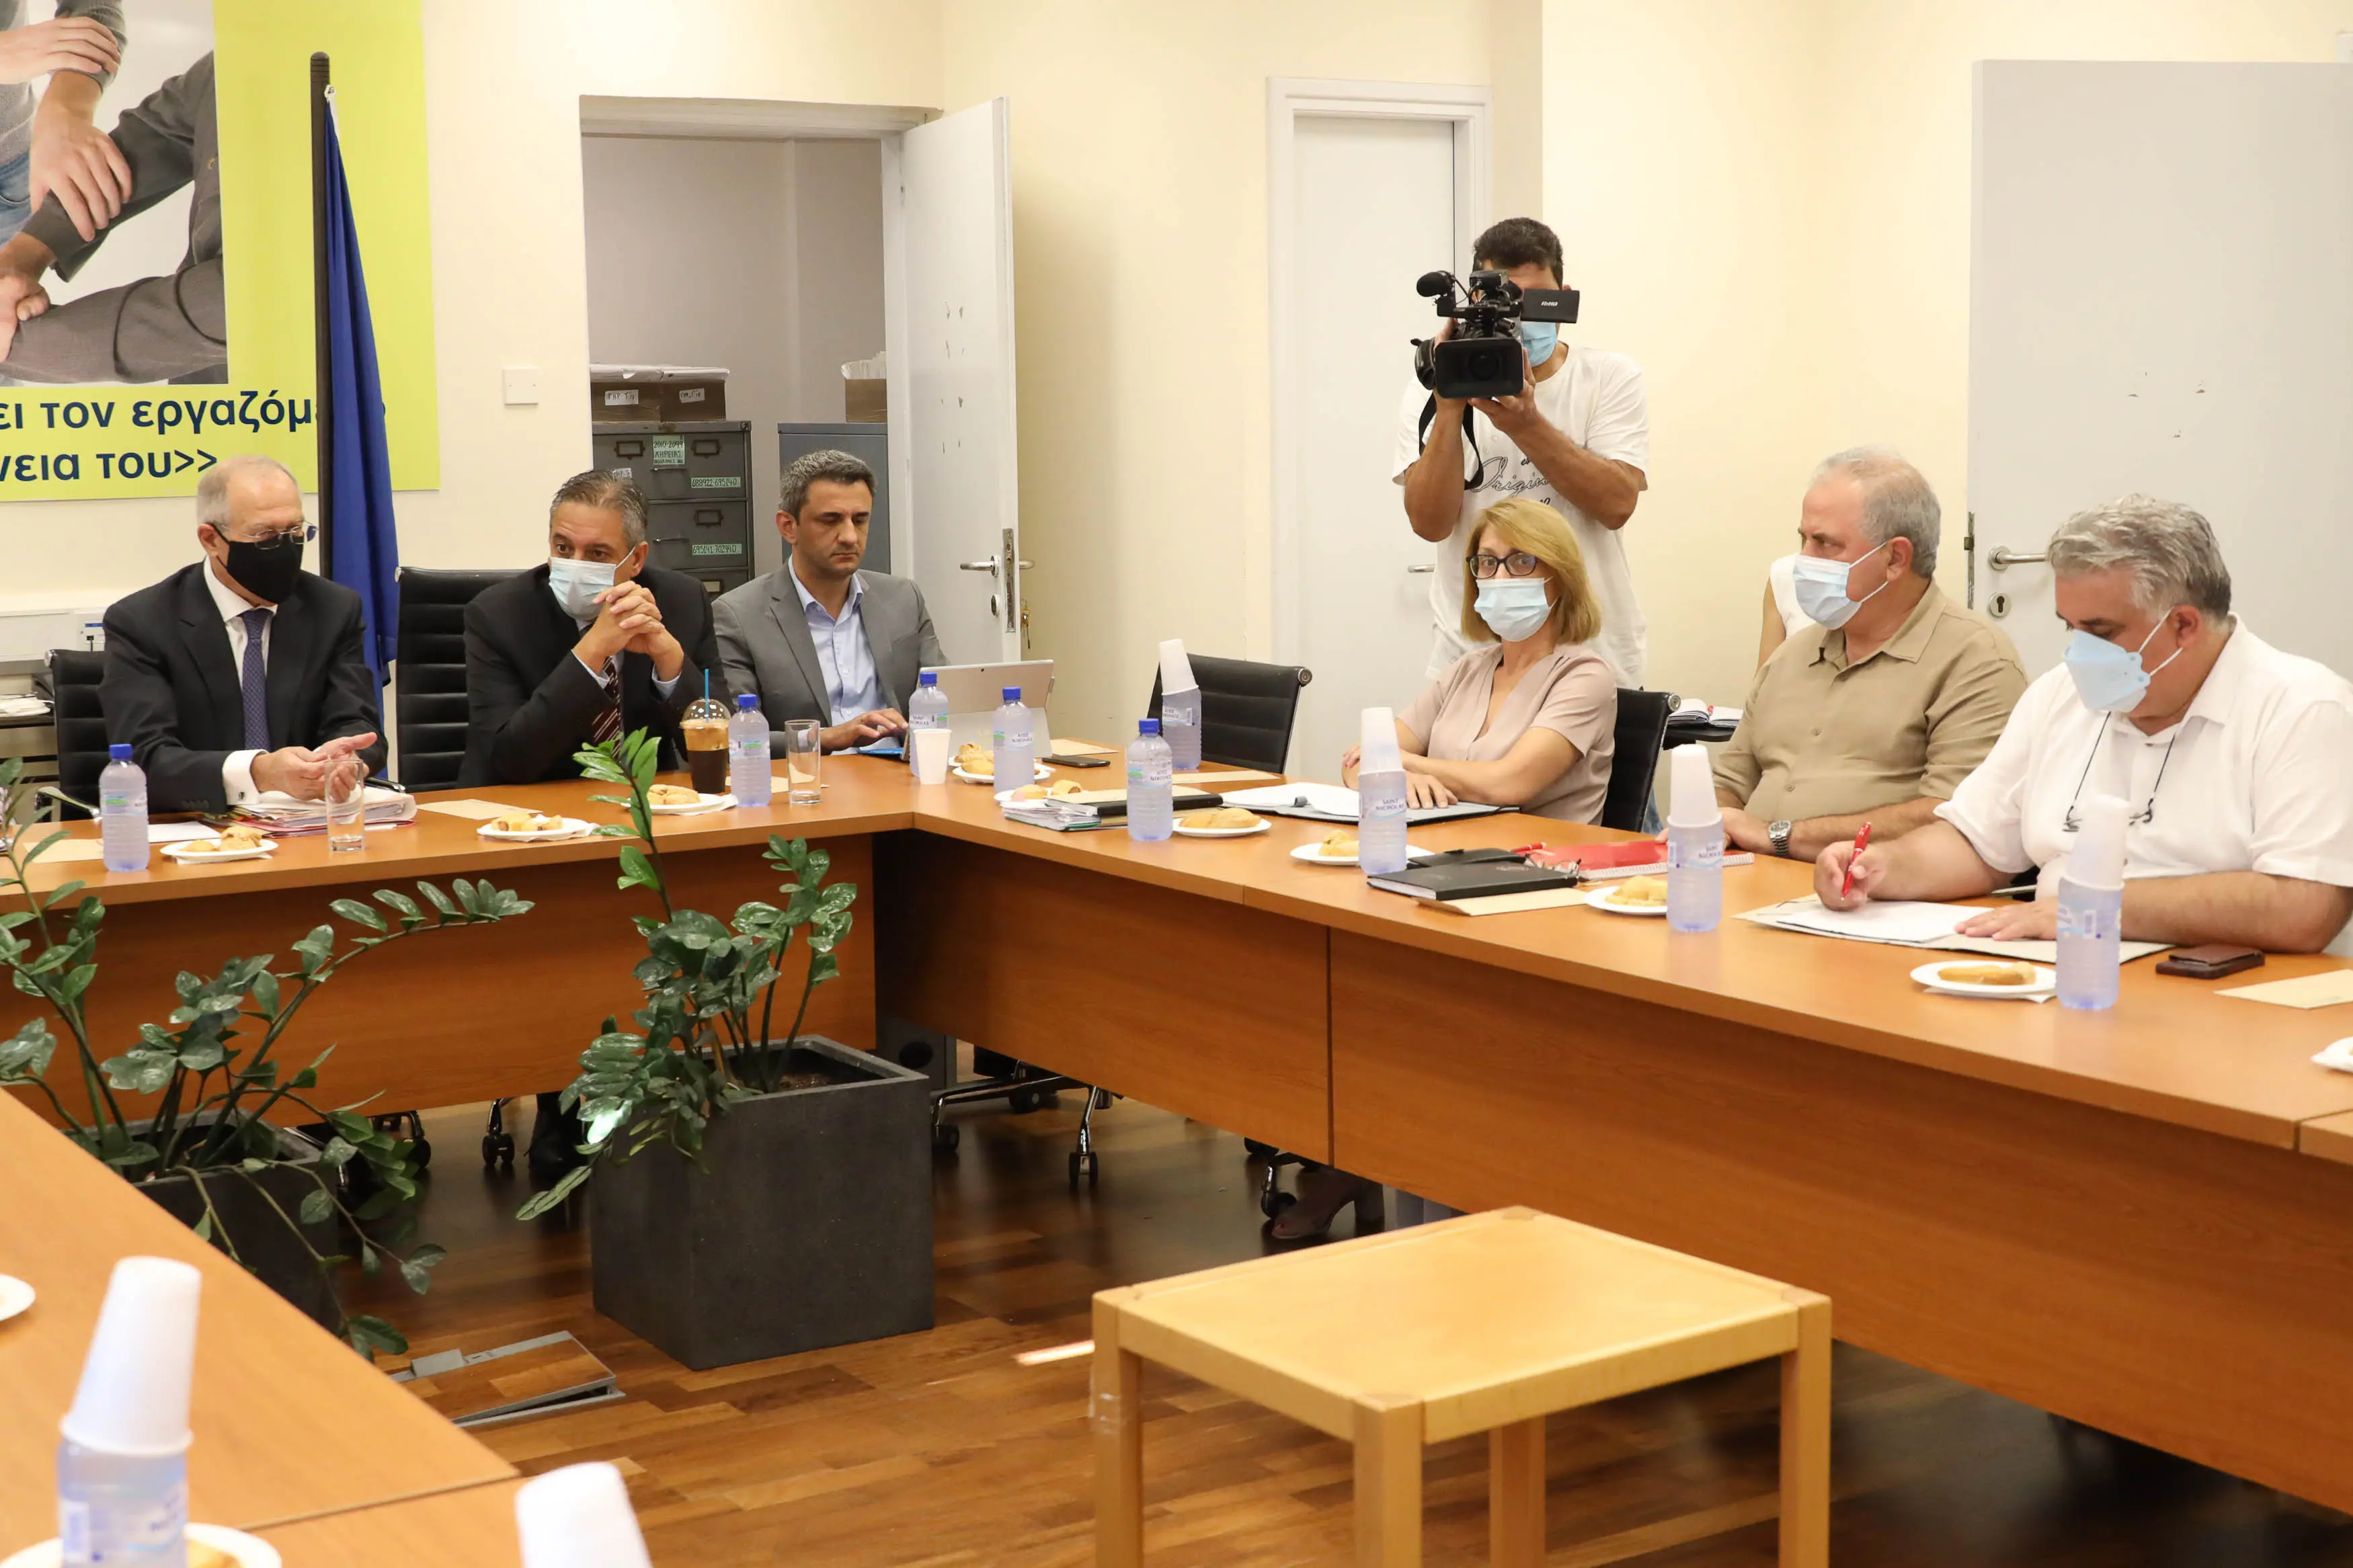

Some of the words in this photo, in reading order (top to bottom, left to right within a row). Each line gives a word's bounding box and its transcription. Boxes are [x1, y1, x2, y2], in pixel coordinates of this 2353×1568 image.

[40, 401, 116, 428] τον
[132, 390, 385, 435] εργαζόμ
[95, 448, 218, 479] του>>
